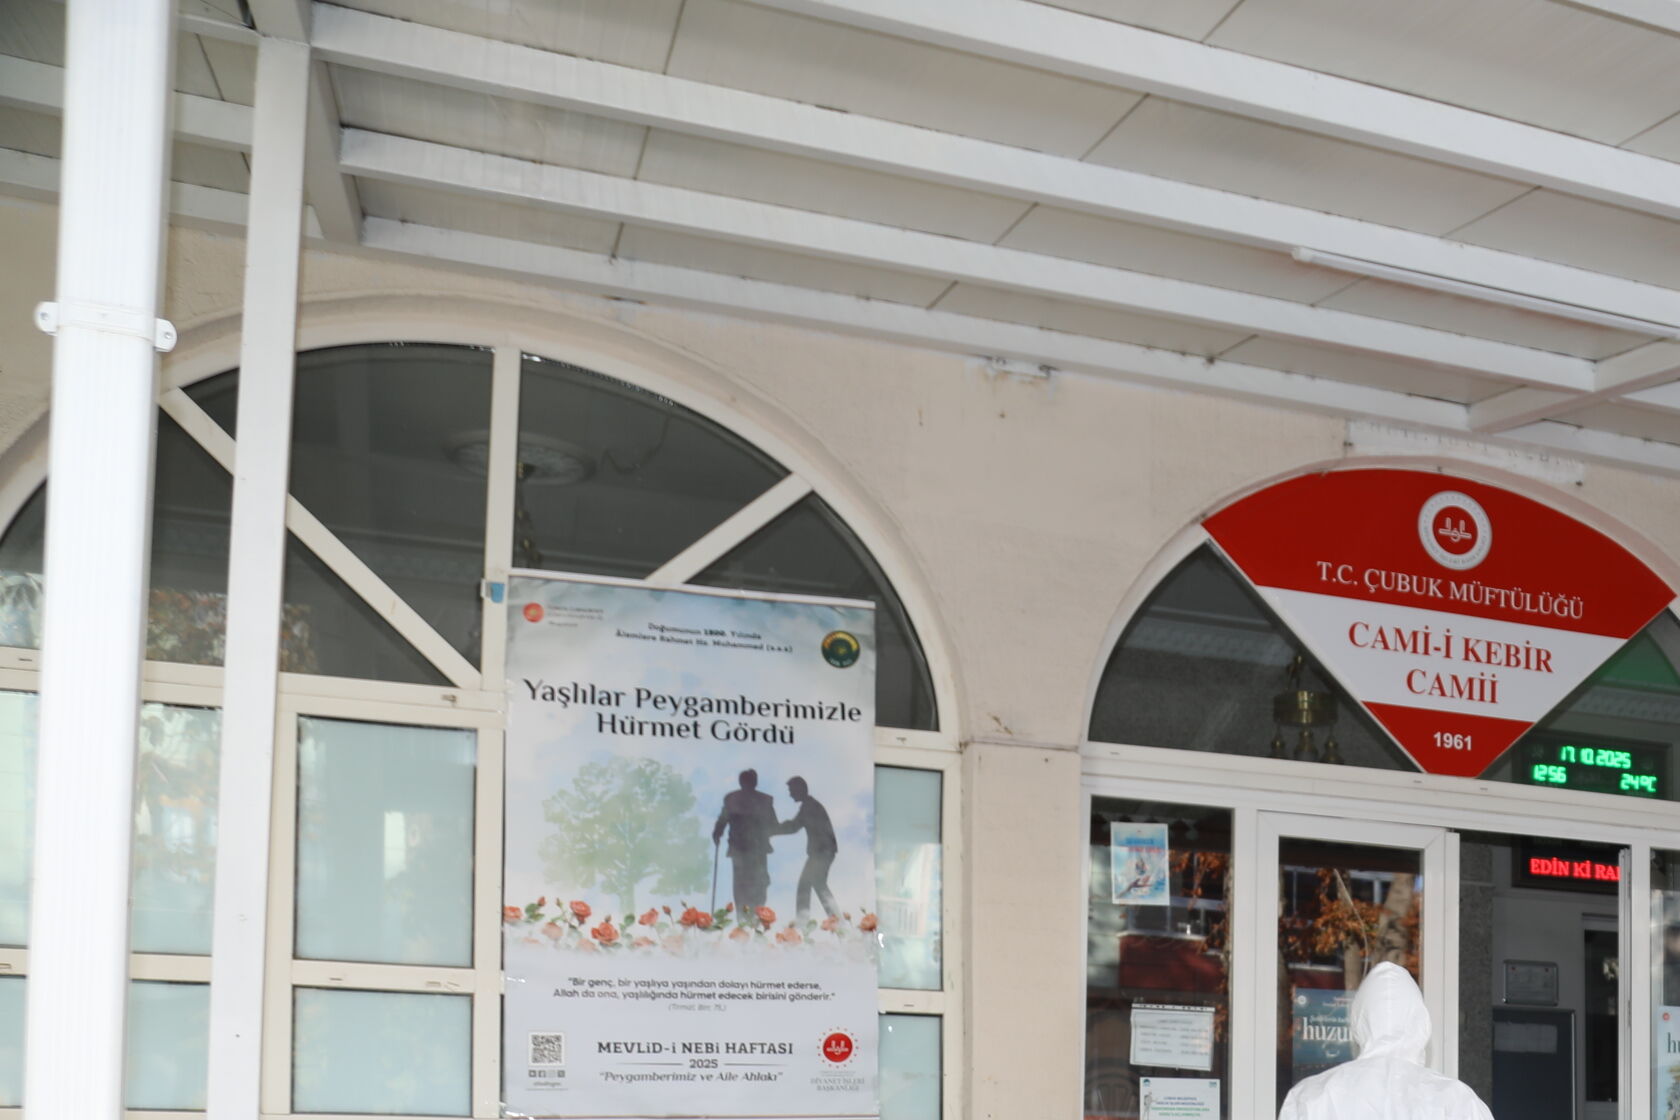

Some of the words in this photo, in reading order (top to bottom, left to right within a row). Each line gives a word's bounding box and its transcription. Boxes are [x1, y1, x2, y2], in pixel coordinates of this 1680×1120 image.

[1316, 560, 1358, 586] T.C.
[1363, 568, 1443, 598] ÇUBUK
[1449, 580, 1584, 620] MÜFTÜLÜĞÜ
[659, 635, 693, 645] Rahmet
[713, 639, 764, 651] Muhammed
[1348, 620, 1453, 659] CAMİ-İ
[1461, 636, 1555, 674] KEBİR
[1406, 668, 1499, 704] CAMİİ
[523, 678, 627, 709] Yaşlılar
[635, 687, 862, 721] Peygamberimizle
[596, 711, 701, 740] Hürmet
[710, 719, 795, 745] Gördü
[1433, 731, 1472, 751] 1961
[1530, 857, 1570, 877] EDİN
[1572, 860, 1592, 879] Kİ
[553, 988, 580, 998] Allah
[581, 989, 596, 998] da
[680, 990, 716, 1000] hürmet
[718, 991, 753, 1001] edecek
[755, 991, 787, 1001] birisini
[718, 980, 749, 991] dolayı
[750, 980, 786, 990] hürmet
[725, 1042, 794, 1055] HAFTASI
[689, 1058, 718, 1069] 2025
[699, 1073, 714, 1082] ve
[716, 1072, 738, 1082] Aile
